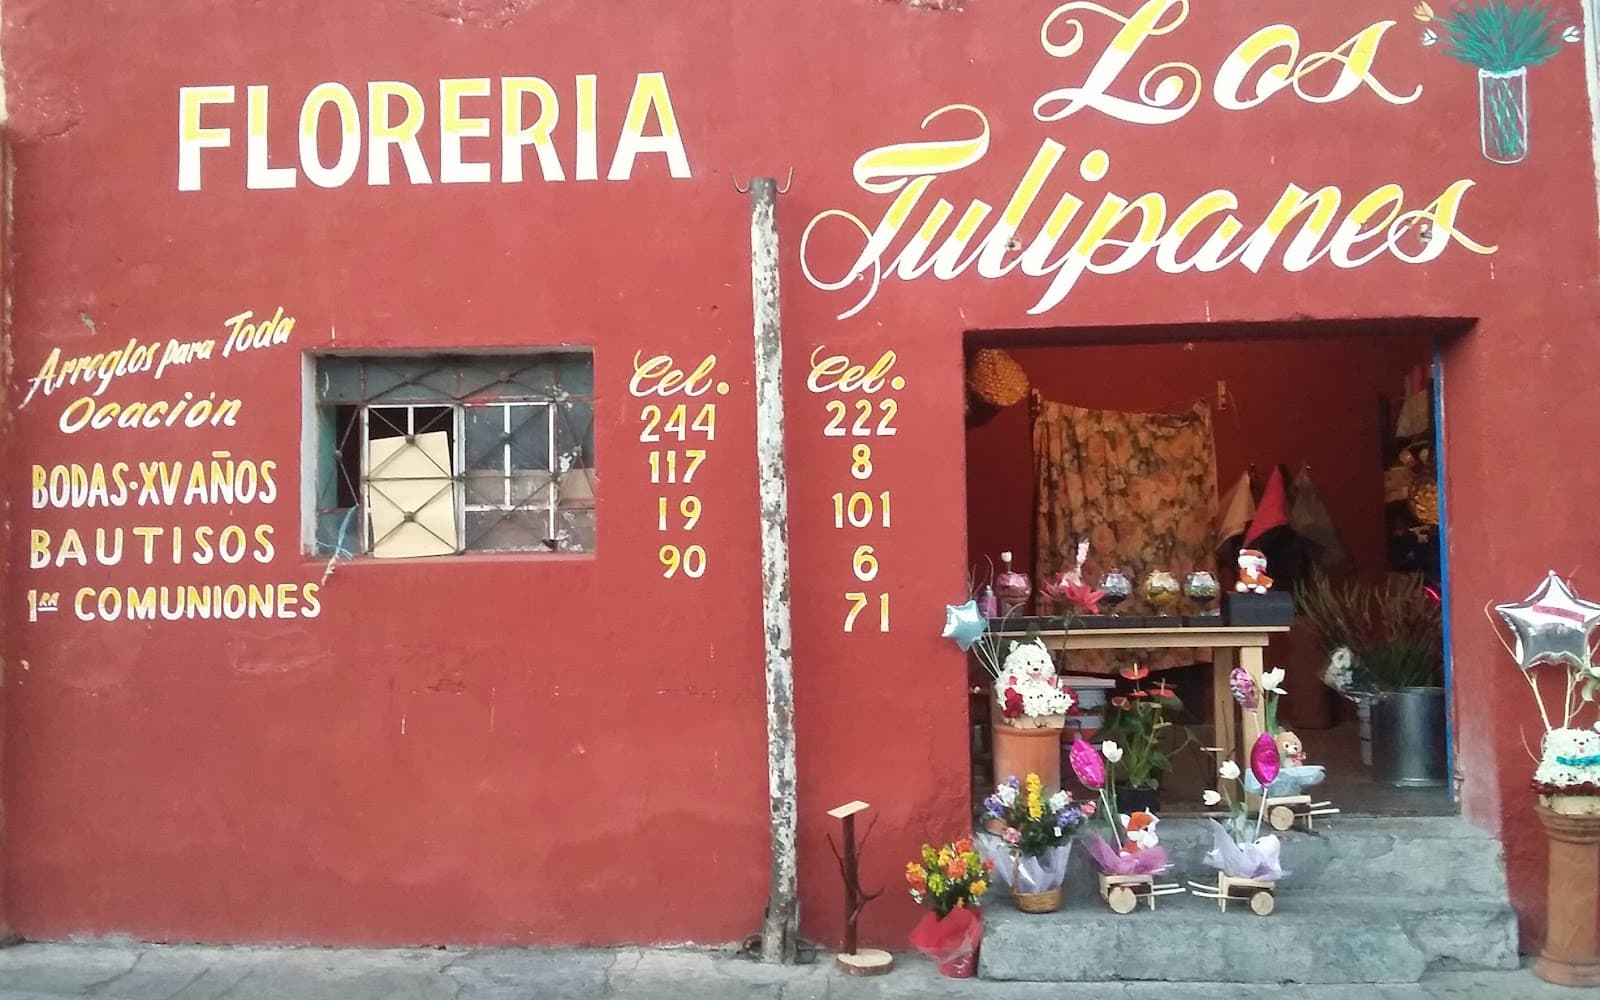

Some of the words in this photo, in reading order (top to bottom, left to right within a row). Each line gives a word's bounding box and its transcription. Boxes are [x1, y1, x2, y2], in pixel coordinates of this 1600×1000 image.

[1032, 0, 1423, 125] Los
[178, 72, 692, 192] FLORERIA
[800, 103, 1498, 320] Tulipanes
[18, 336, 157, 409] Arreglos
[156, 338, 216, 380] para
[222, 306, 297, 359] Toda
[629, 349, 730, 397] Cel.
[807, 345, 906, 393] Cel.
[59, 391, 242, 434] Ocación
[640, 403, 716, 442] 244
[824, 398, 898, 436] 222
[183, 451, 277, 505] AÑOS
[649, 450, 706, 483] 117
[851, 443, 873, 480] 8
[658, 496, 702, 531] 19
[832, 491, 891, 528] 101
[30, 524, 275, 569] BAUTISOS
[659, 545, 707, 578] 90
[852, 545, 879, 582] 6
[75, 583, 321, 621] COMUNIONES
[843, 592, 890, 632] 71
